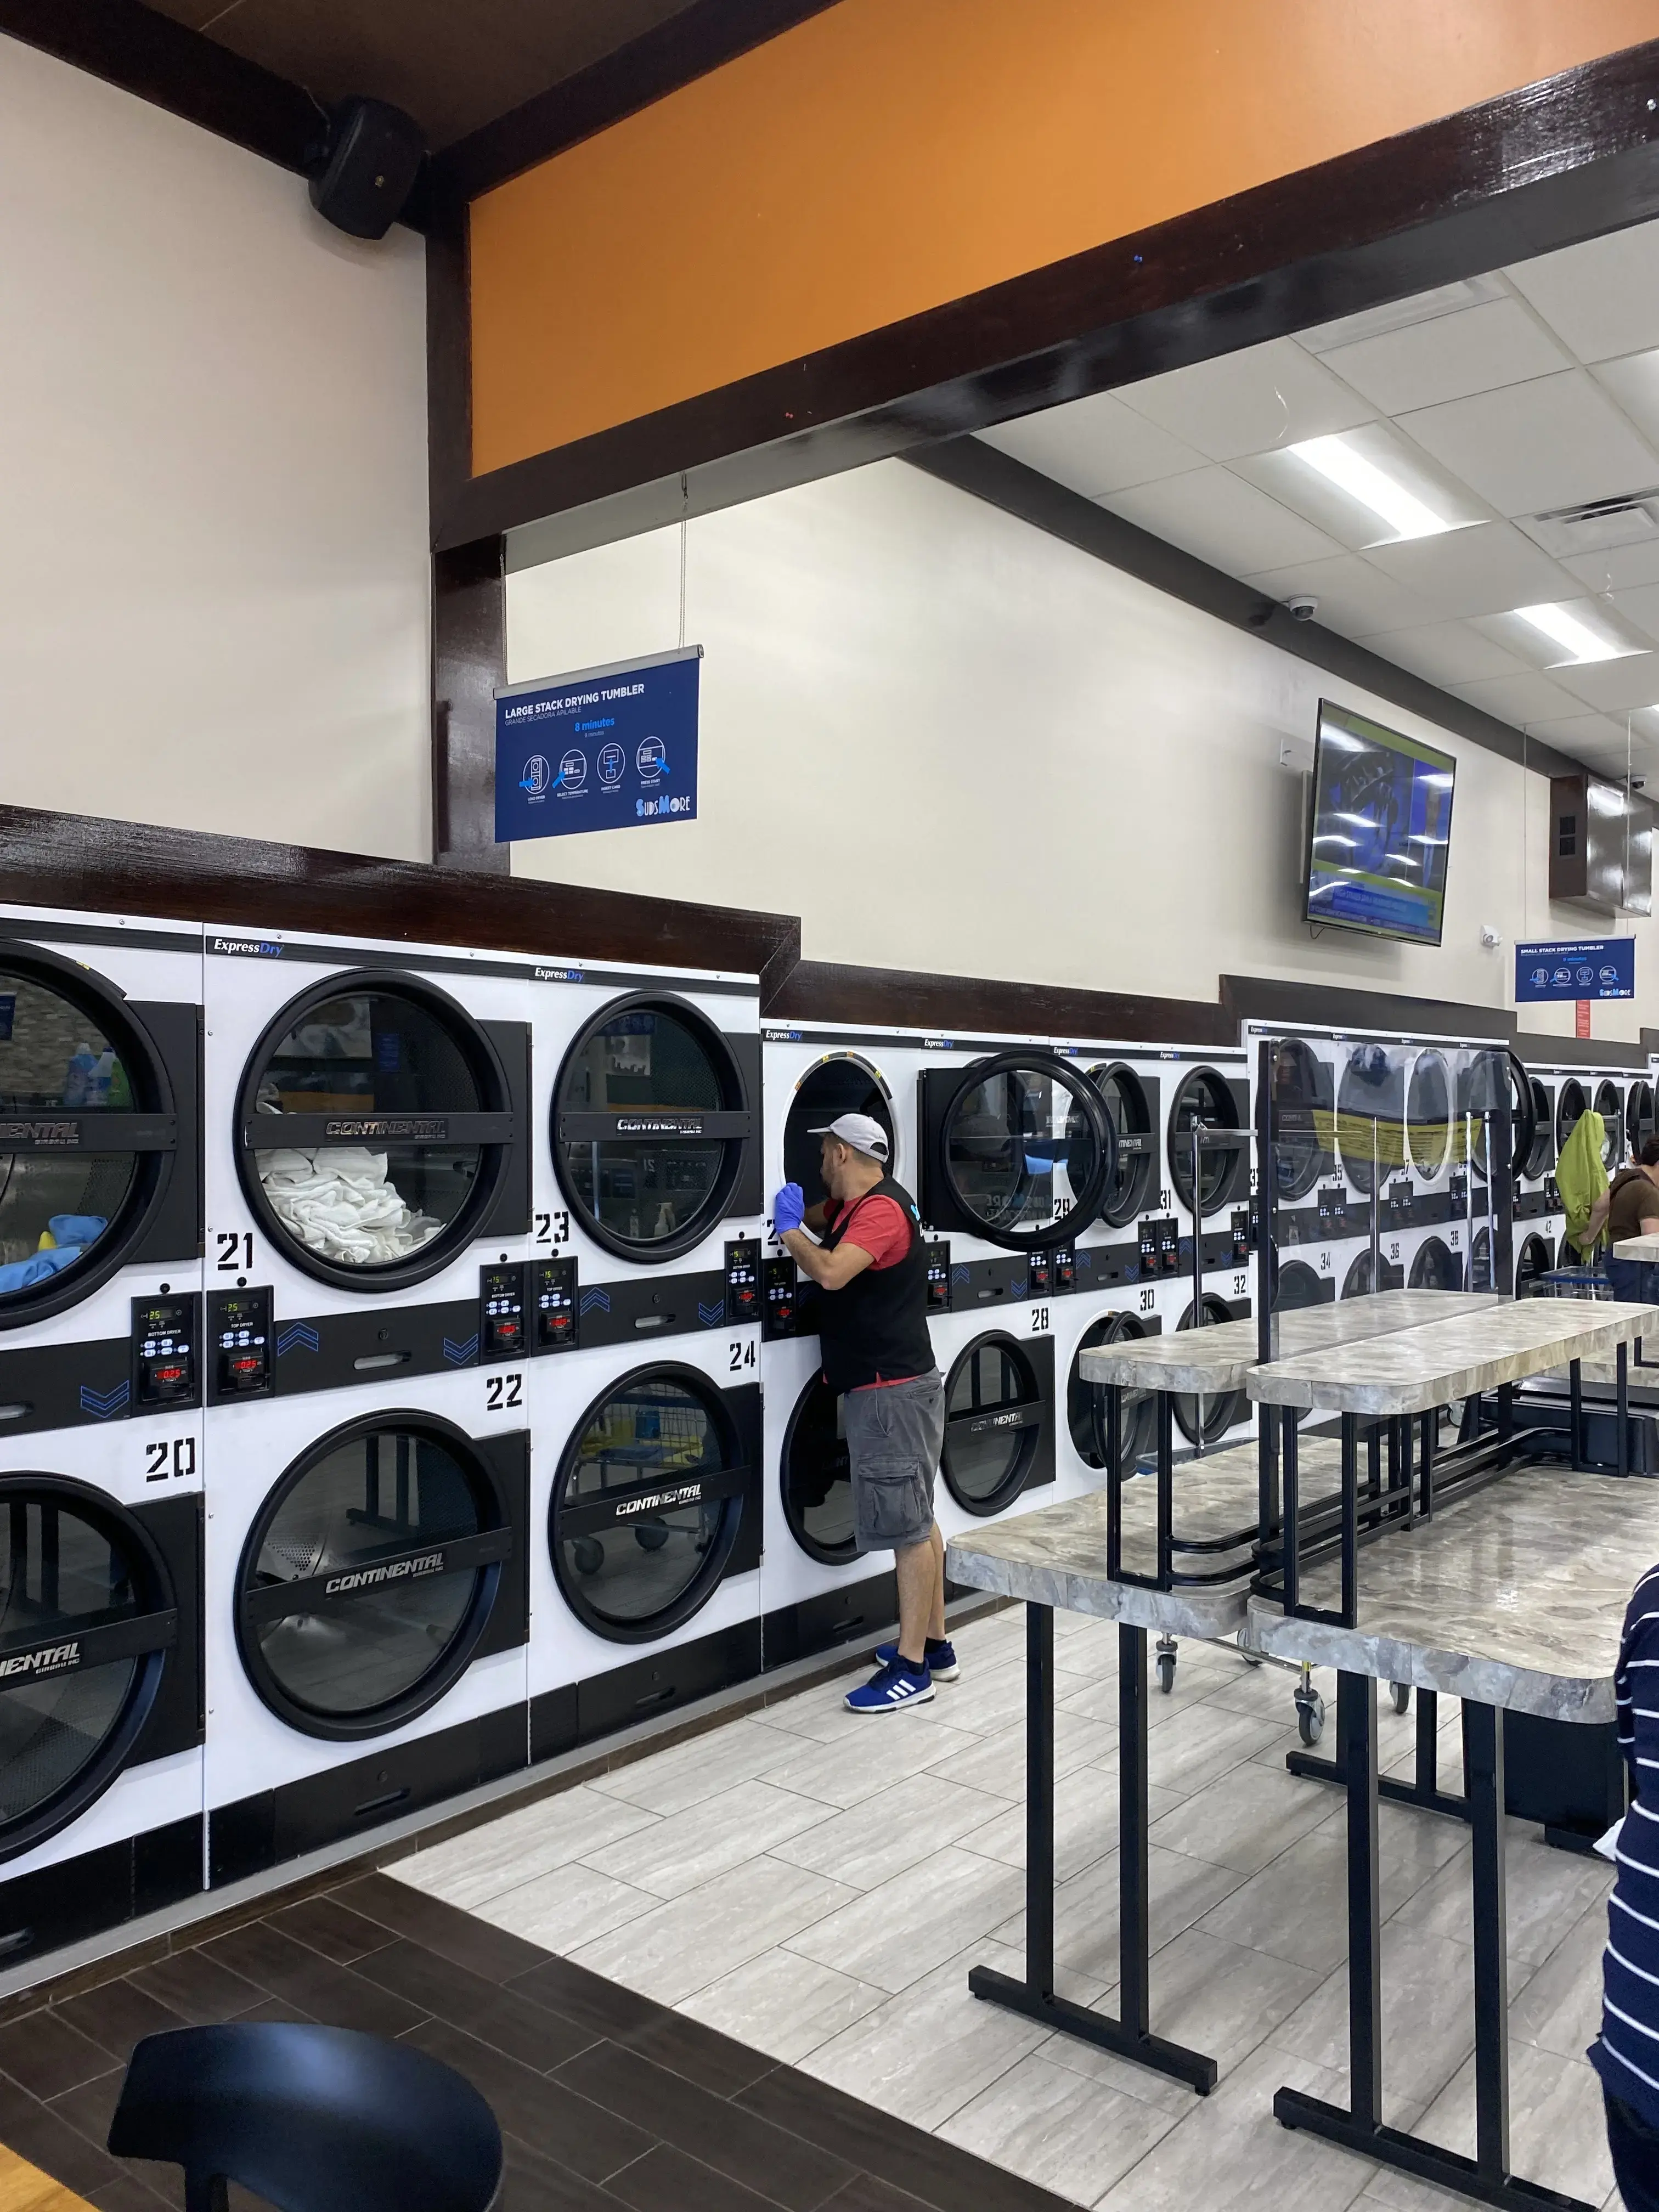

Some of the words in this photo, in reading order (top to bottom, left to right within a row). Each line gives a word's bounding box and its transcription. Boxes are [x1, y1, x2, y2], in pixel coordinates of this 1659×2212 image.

[505, 704, 534, 719] LARGE
[535, 699, 563, 713] STACK
[565, 692, 599, 708] DRYING
[601, 684, 645, 701] TUMBLER
[505, 716, 526, 726] GRANDE
[527, 712, 556, 723] SECADORA
[556, 706, 582, 717] APILABLE
[574, 722, 580, 732] 8
[582, 717, 616, 731] minutes
[214, 939, 283, 958] ExpressDry
[535, 967, 584, 983] ExpressDry
[766, 1030, 802, 1041] ExpressDry
[924, 1039, 953, 1049] ExpressDry
[1053, 1047, 1078, 1057] ExpressDry
[1160, 1052, 1180, 1060] ExpressDry
[326, 1120, 445, 1135] CONTINENTAL
[617, 1118, 702, 1130] CONTINENTAL
[1160, 1189, 1171, 1210] 31
[534, 1211, 569, 1244] 23
[217, 1233, 254, 1270] 21
[1321, 1251, 1330, 1270] 34
[1390, 1243, 1400, 1259] 36
[1234, 1274, 1246, 1294] 32
[228, 1303, 238, 1312] 25
[1140, 1289, 1154, 1311] 30
[149, 1311, 160, 1320] 25
[1032, 1307, 1048, 1331] 28
[729, 1340, 755, 1371] 24
[487, 1374, 522, 1411] 22
[145, 1437, 196, 1482] 20
[616, 1483, 701, 1516] CONTINENTAL
[326, 1553, 444, 1594] CONTINENTAL
